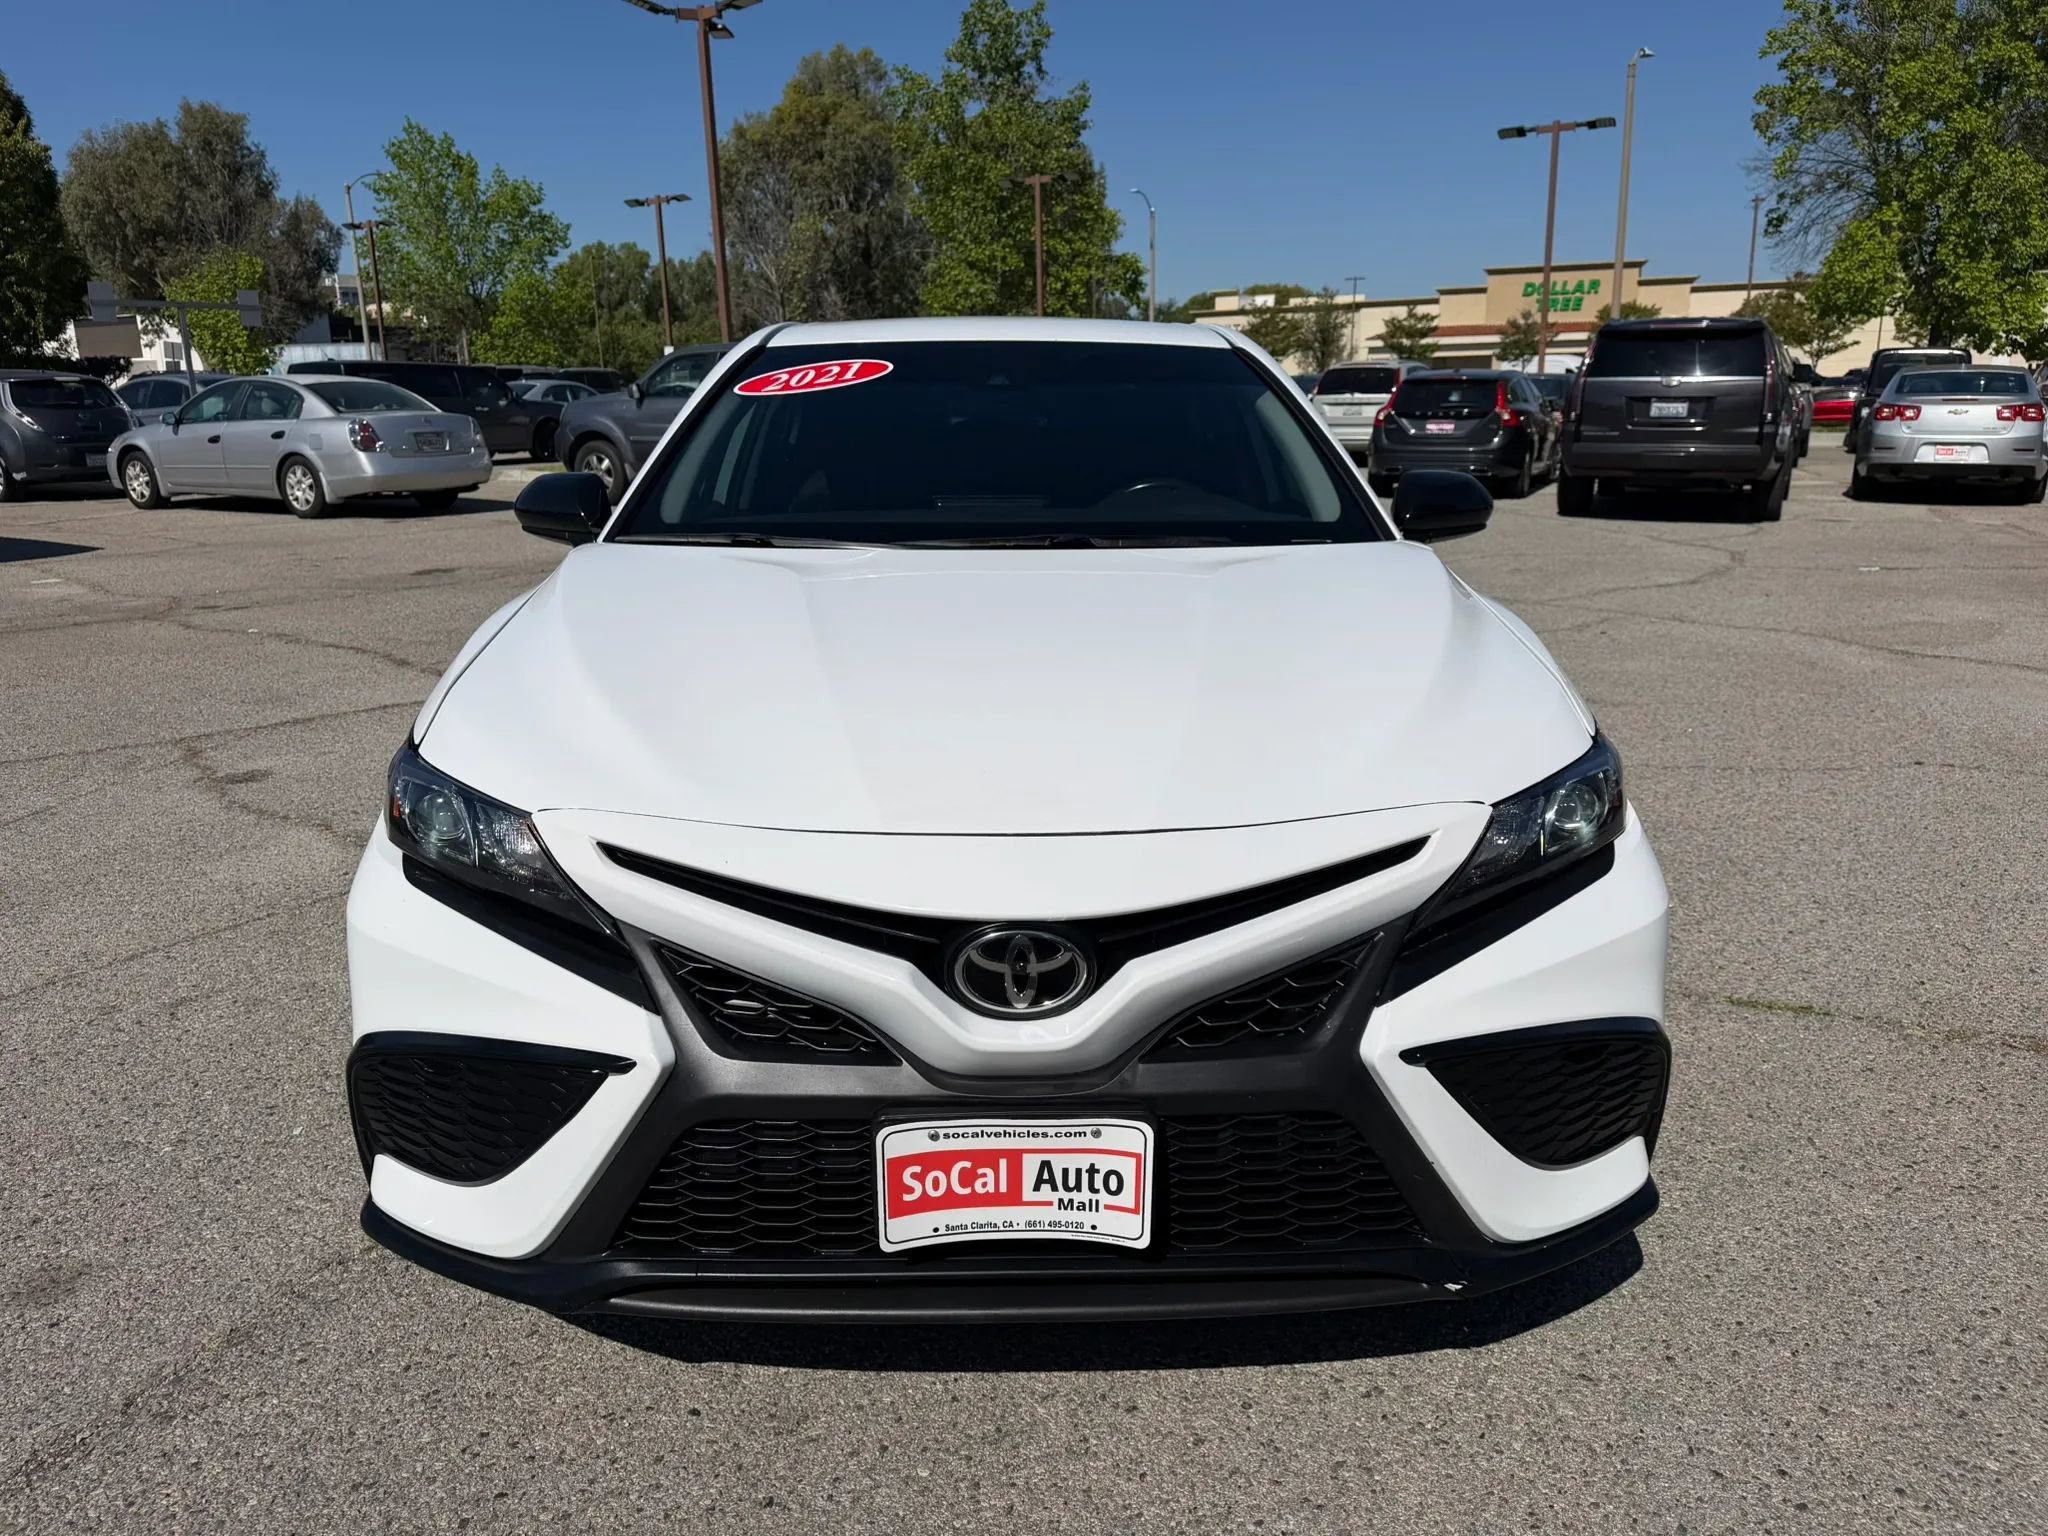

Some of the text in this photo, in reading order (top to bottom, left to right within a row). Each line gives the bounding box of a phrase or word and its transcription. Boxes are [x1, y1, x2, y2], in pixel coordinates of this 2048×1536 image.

[761, 362, 863, 392] 2021
[942, 1129, 1087, 1140] socalvehicles.com
[902, 1158, 1124, 1201] SoCal Auto
[1057, 1197, 1100, 1213] Mall
[944, 1220, 1085, 1232] Santa Clarita, CA (661) 495-0120
